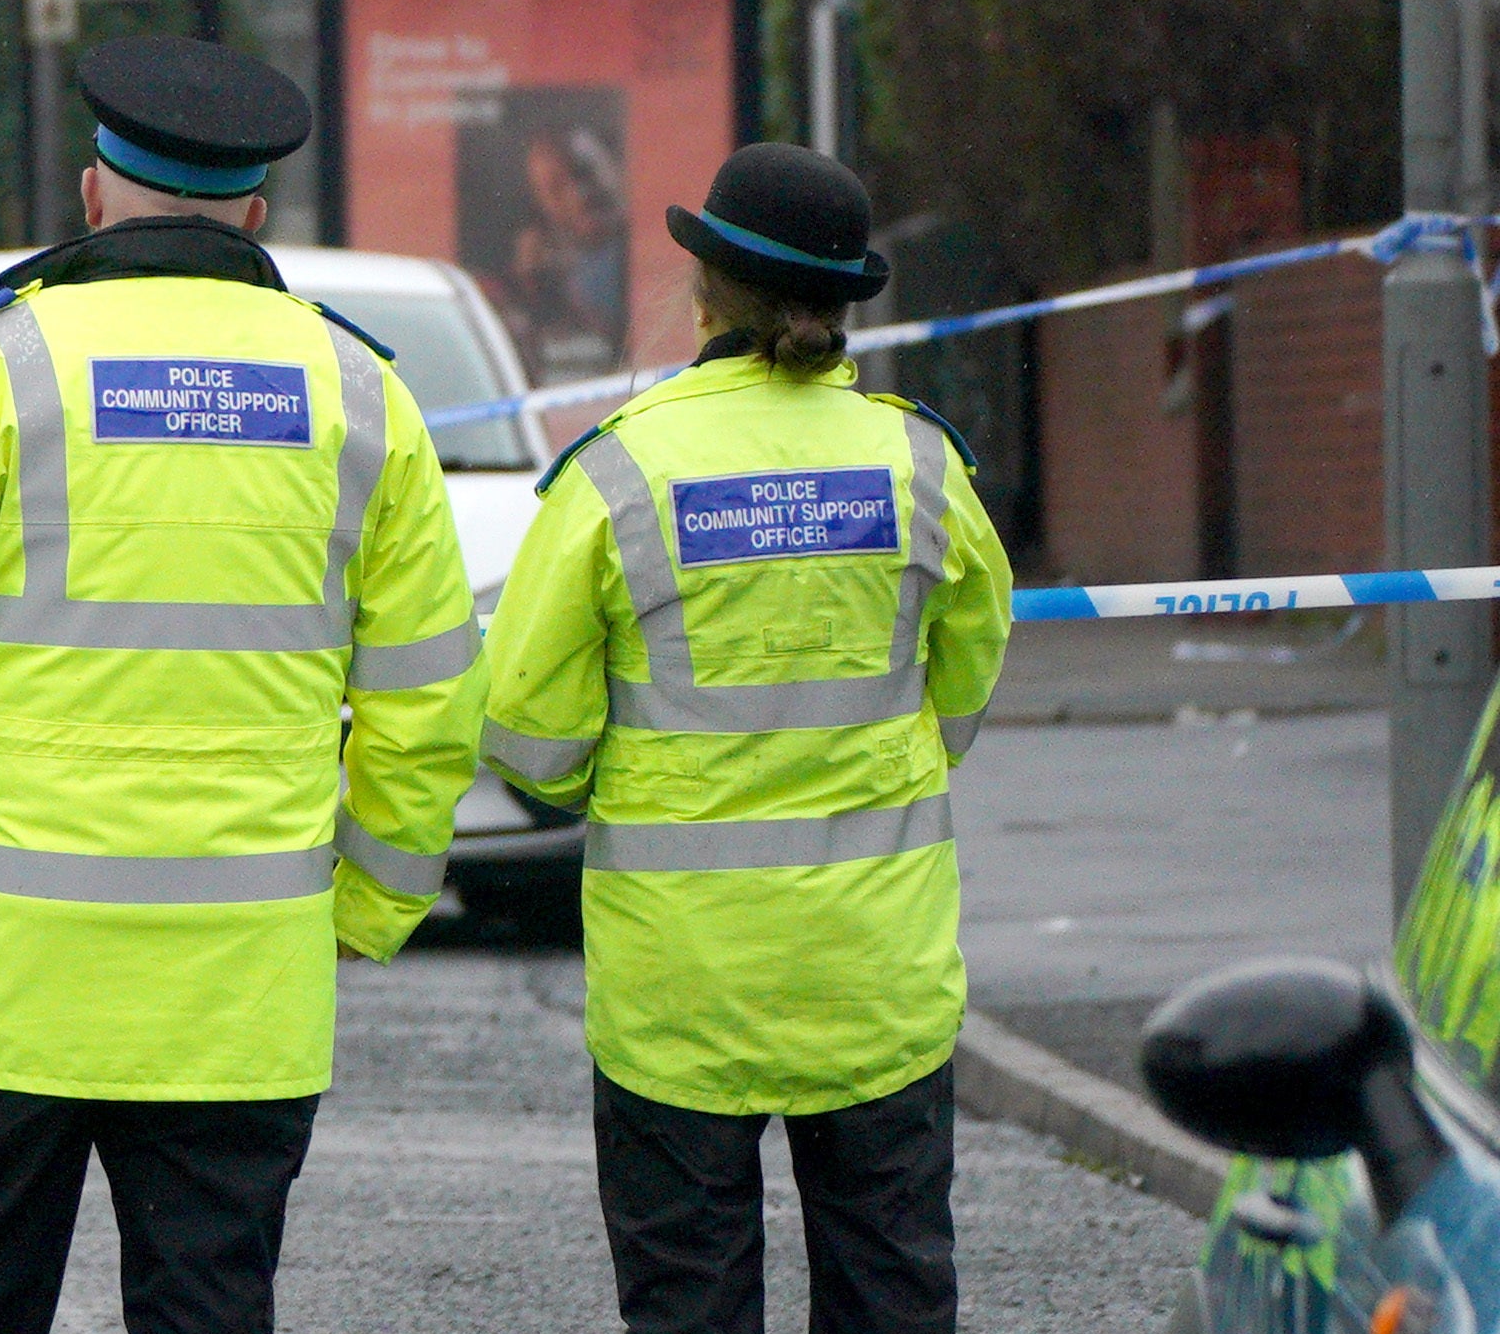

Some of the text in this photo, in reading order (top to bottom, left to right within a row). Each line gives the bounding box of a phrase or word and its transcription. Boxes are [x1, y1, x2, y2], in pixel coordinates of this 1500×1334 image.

[169, 367, 234, 388] POLICE
[102, 389, 301, 413] COMMUNITY SUPPORT
[165, 412, 242, 433] OFFICER
[751, 480, 817, 503] POLICE
[685, 499, 887, 532] COMMUNITY SUPPORT
[751, 525, 828, 549] OFFICER
